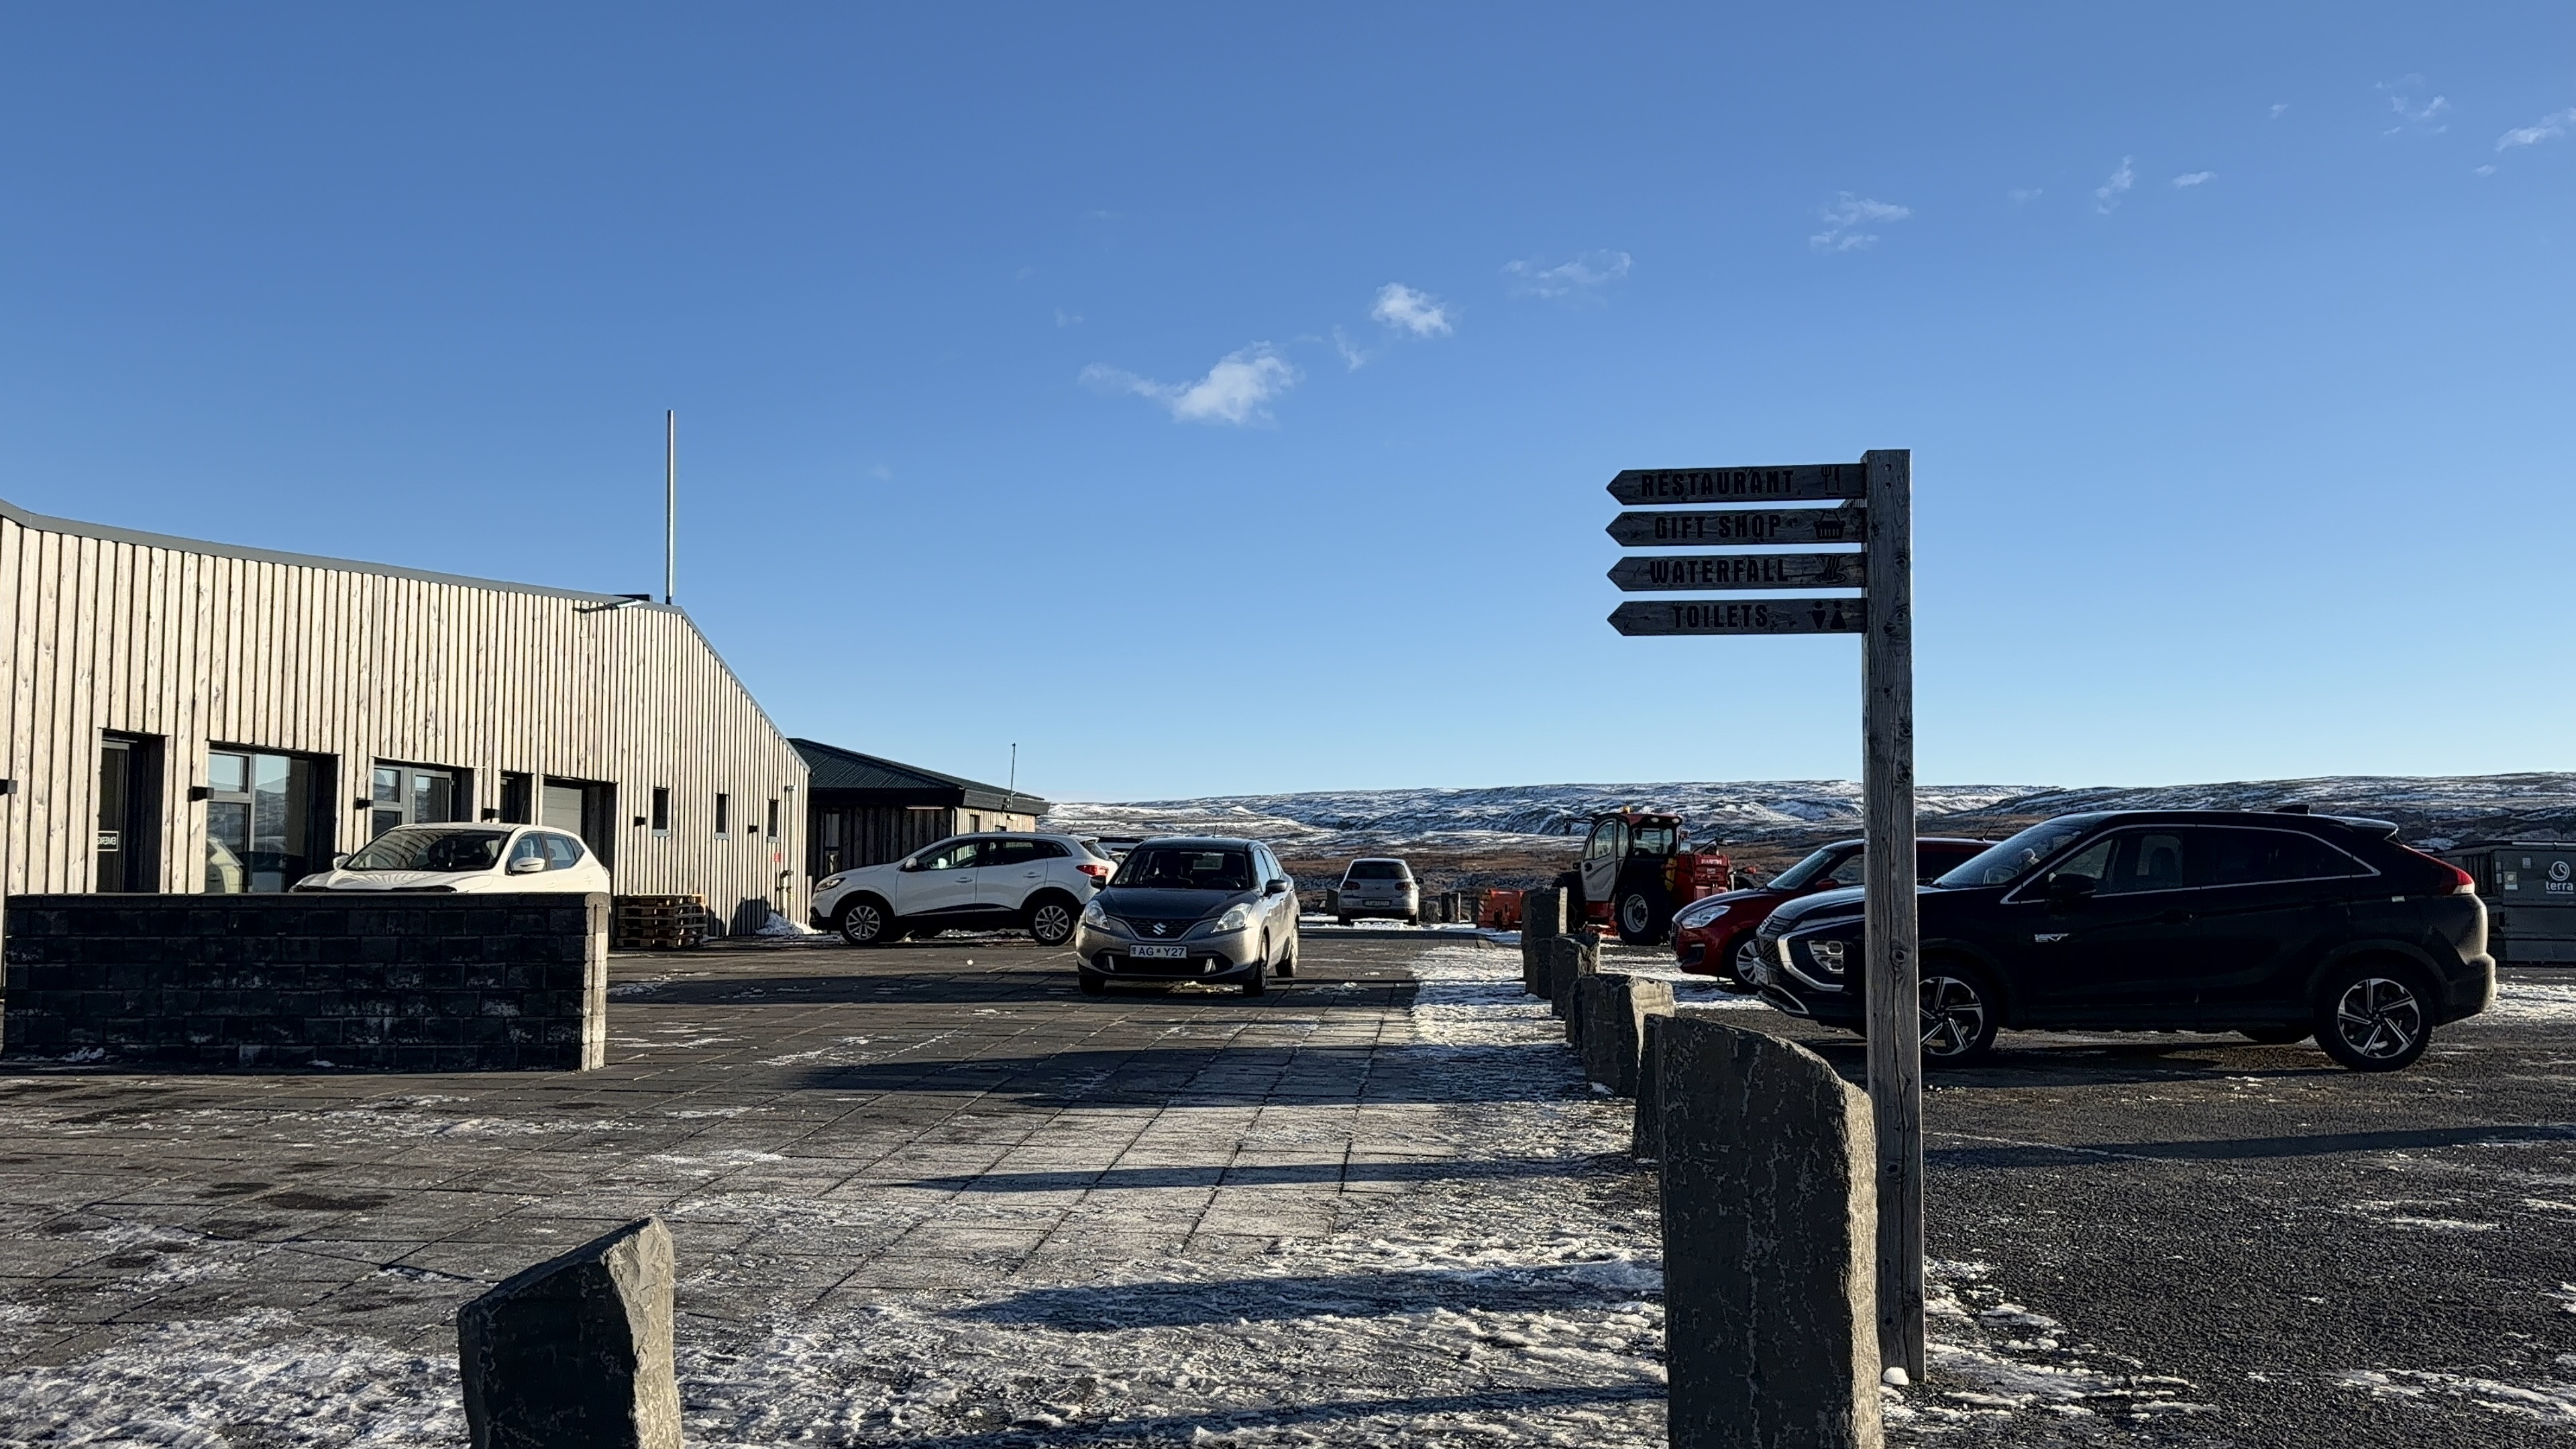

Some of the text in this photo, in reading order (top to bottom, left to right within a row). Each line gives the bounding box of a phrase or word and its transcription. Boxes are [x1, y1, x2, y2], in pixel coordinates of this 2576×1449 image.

[1642, 470, 1793, 497] RESTAURANT
[1655, 515, 1781, 539] GIFT SHOP
[1650, 559, 1788, 583] WATERFALL
[1672, 604, 1768, 628] TOILETS
[2546, 881, 2574, 891] terra
[1138, 947, 1185, 957] AG Y27
